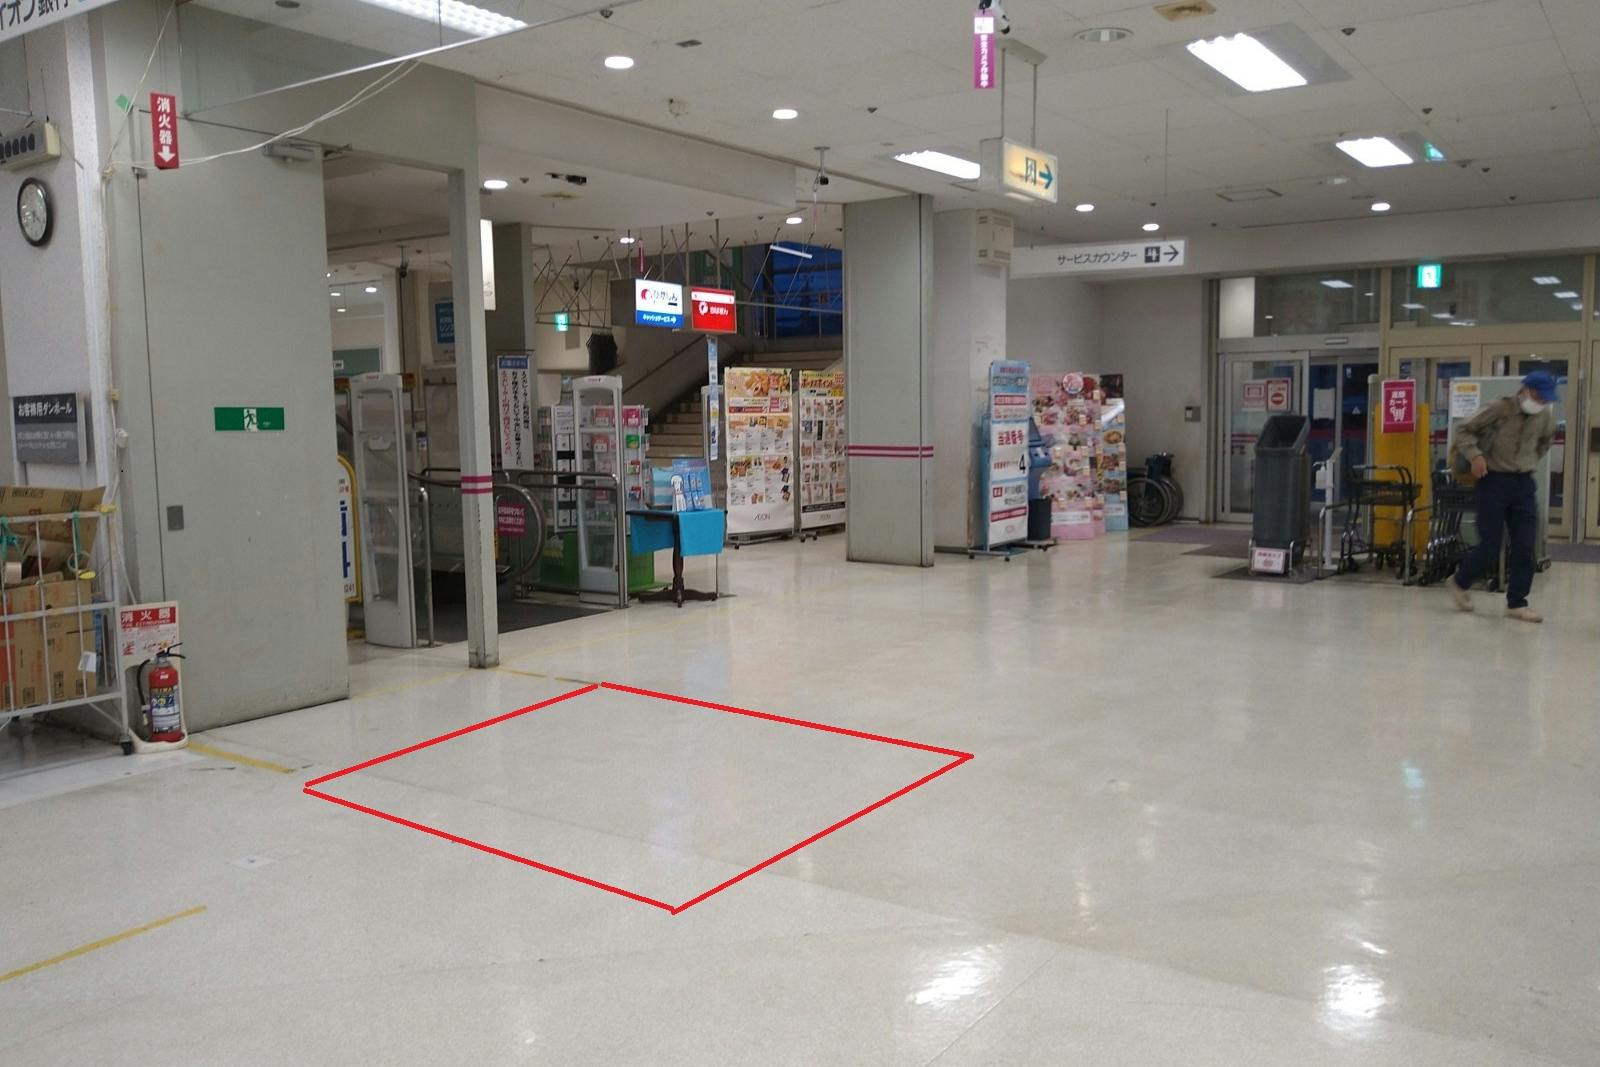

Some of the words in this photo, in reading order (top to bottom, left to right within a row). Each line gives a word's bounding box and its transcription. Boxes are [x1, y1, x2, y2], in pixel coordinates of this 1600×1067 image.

[155, 96, 173, 146] 消火器
[1057, 250, 1138, 265] サービスカウンター
[18, 401, 73, 417] お客様用ダンボール
[1018, 453, 1026, 474] 4
